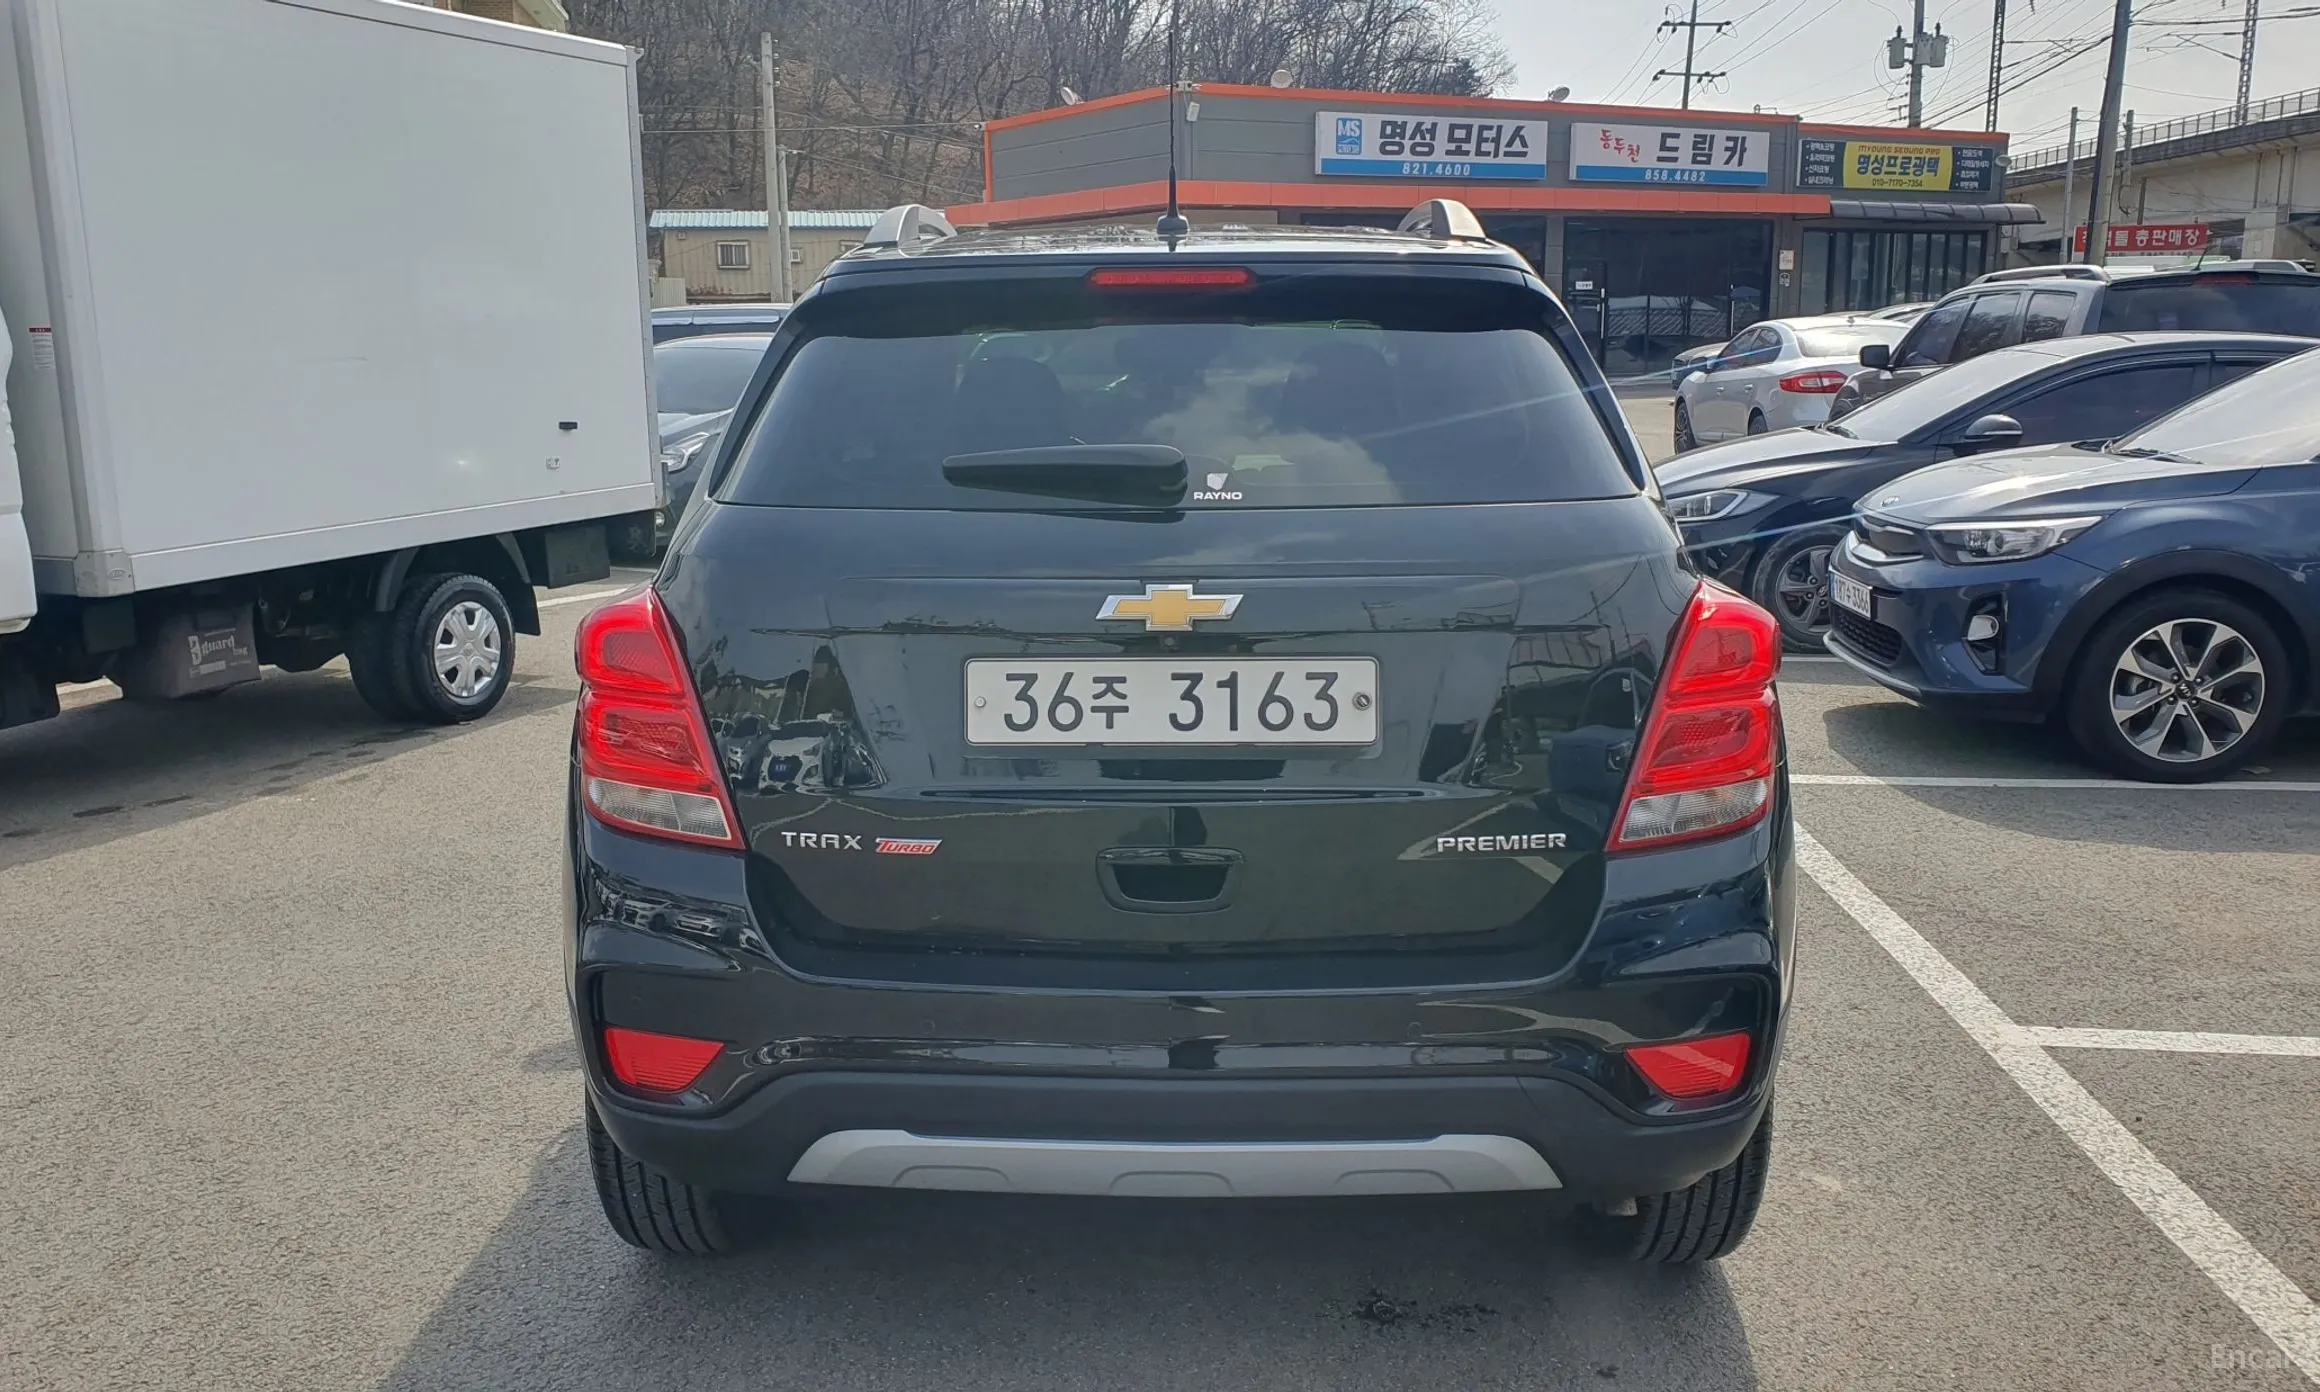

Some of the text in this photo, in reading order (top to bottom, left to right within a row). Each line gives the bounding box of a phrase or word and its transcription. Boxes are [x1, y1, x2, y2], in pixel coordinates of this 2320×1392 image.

[1337, 120, 1361, 137] MS
[1379, 121, 1529, 158] 명성 모터스
[1600, 129, 1640, 163] 동두천
[1402, 162, 1471, 176] 821.4600
[1857, 154, 1940, 177] 명성프로광택
[1645, 169, 1706, 182] 858.4482
[2135, 229, 2200, 247] 총판매장
[1193, 491, 1243, 500] RAYNO
[1004, 671, 1339, 732] 36주 3163
[781, 831, 863, 850] TRAX
[1437, 833, 1567, 852] PREMIER
